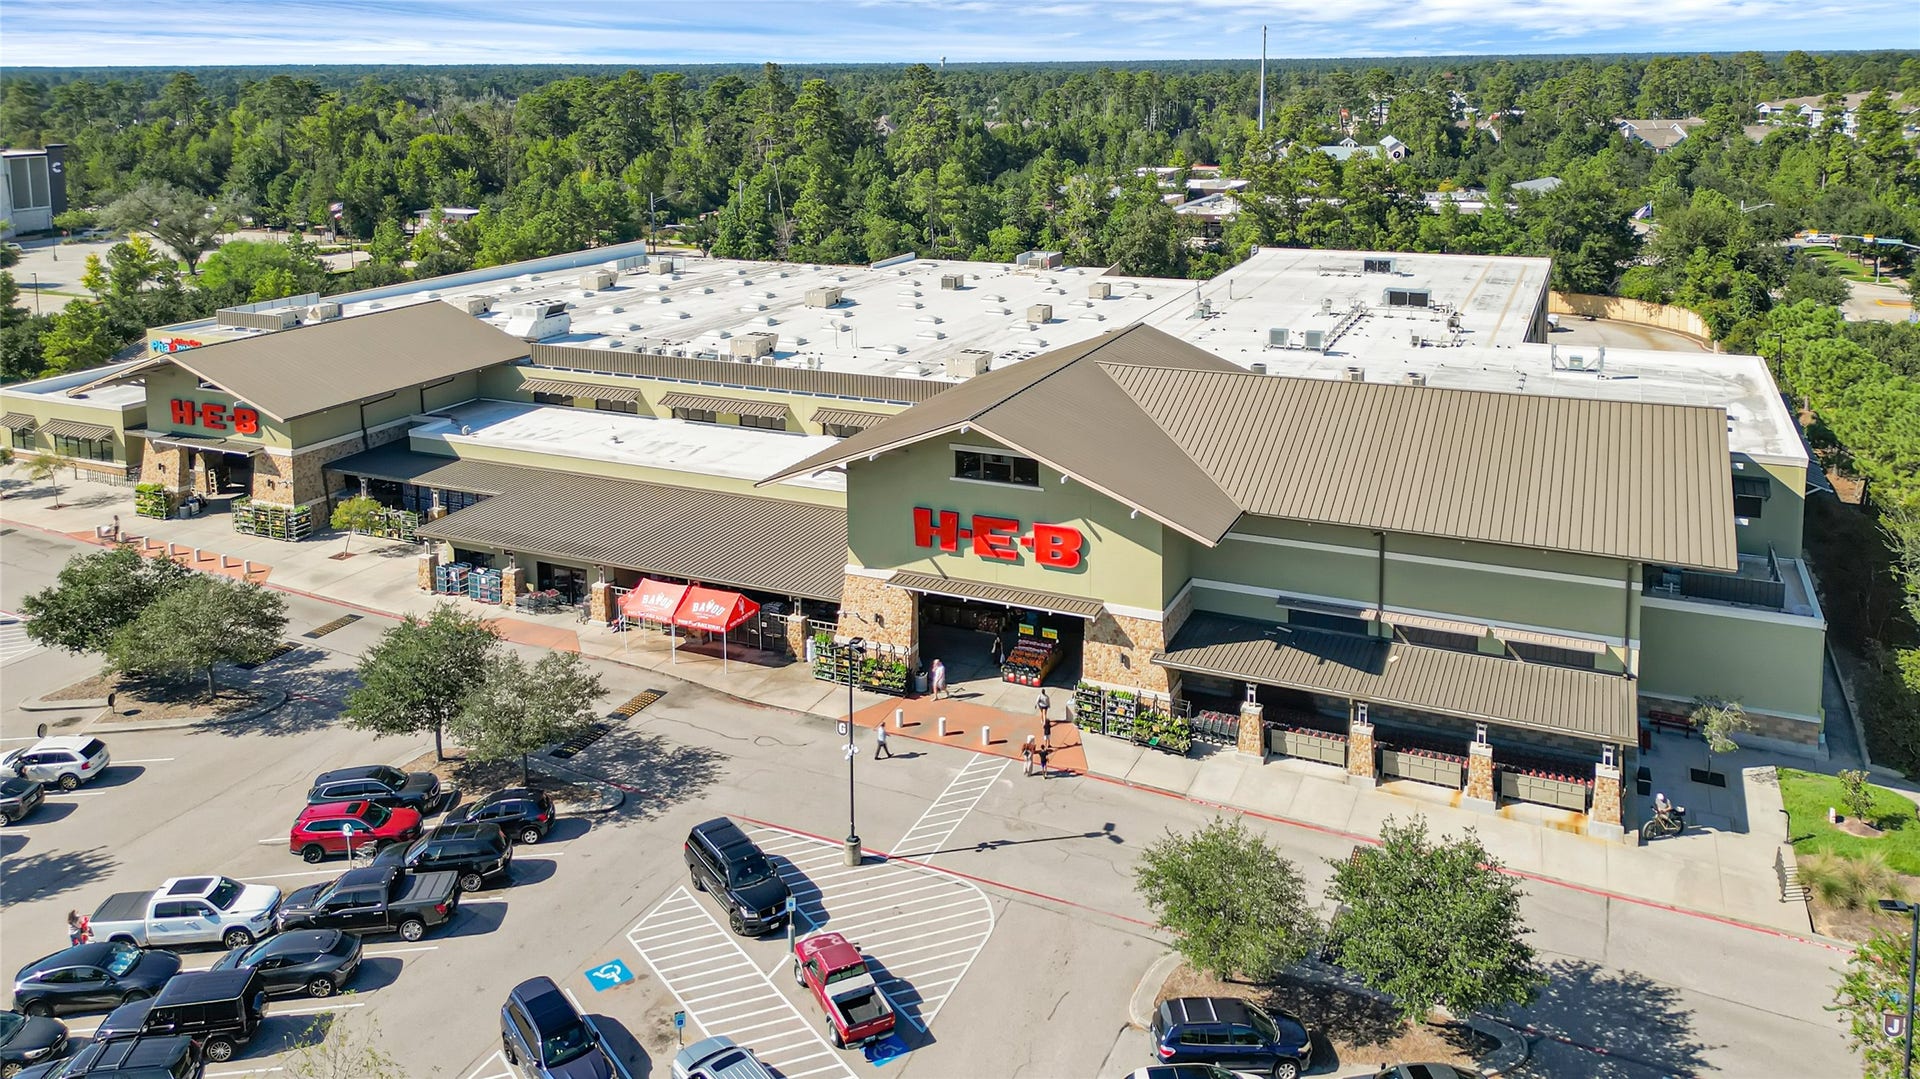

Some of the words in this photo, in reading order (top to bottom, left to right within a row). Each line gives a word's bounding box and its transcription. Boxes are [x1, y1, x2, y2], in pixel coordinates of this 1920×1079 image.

[170, 399, 259, 434] H-E-B
[913, 506, 1083, 569] H-E-B
[838, 723, 848, 734] G
[1887, 1018, 1901, 1034] J
